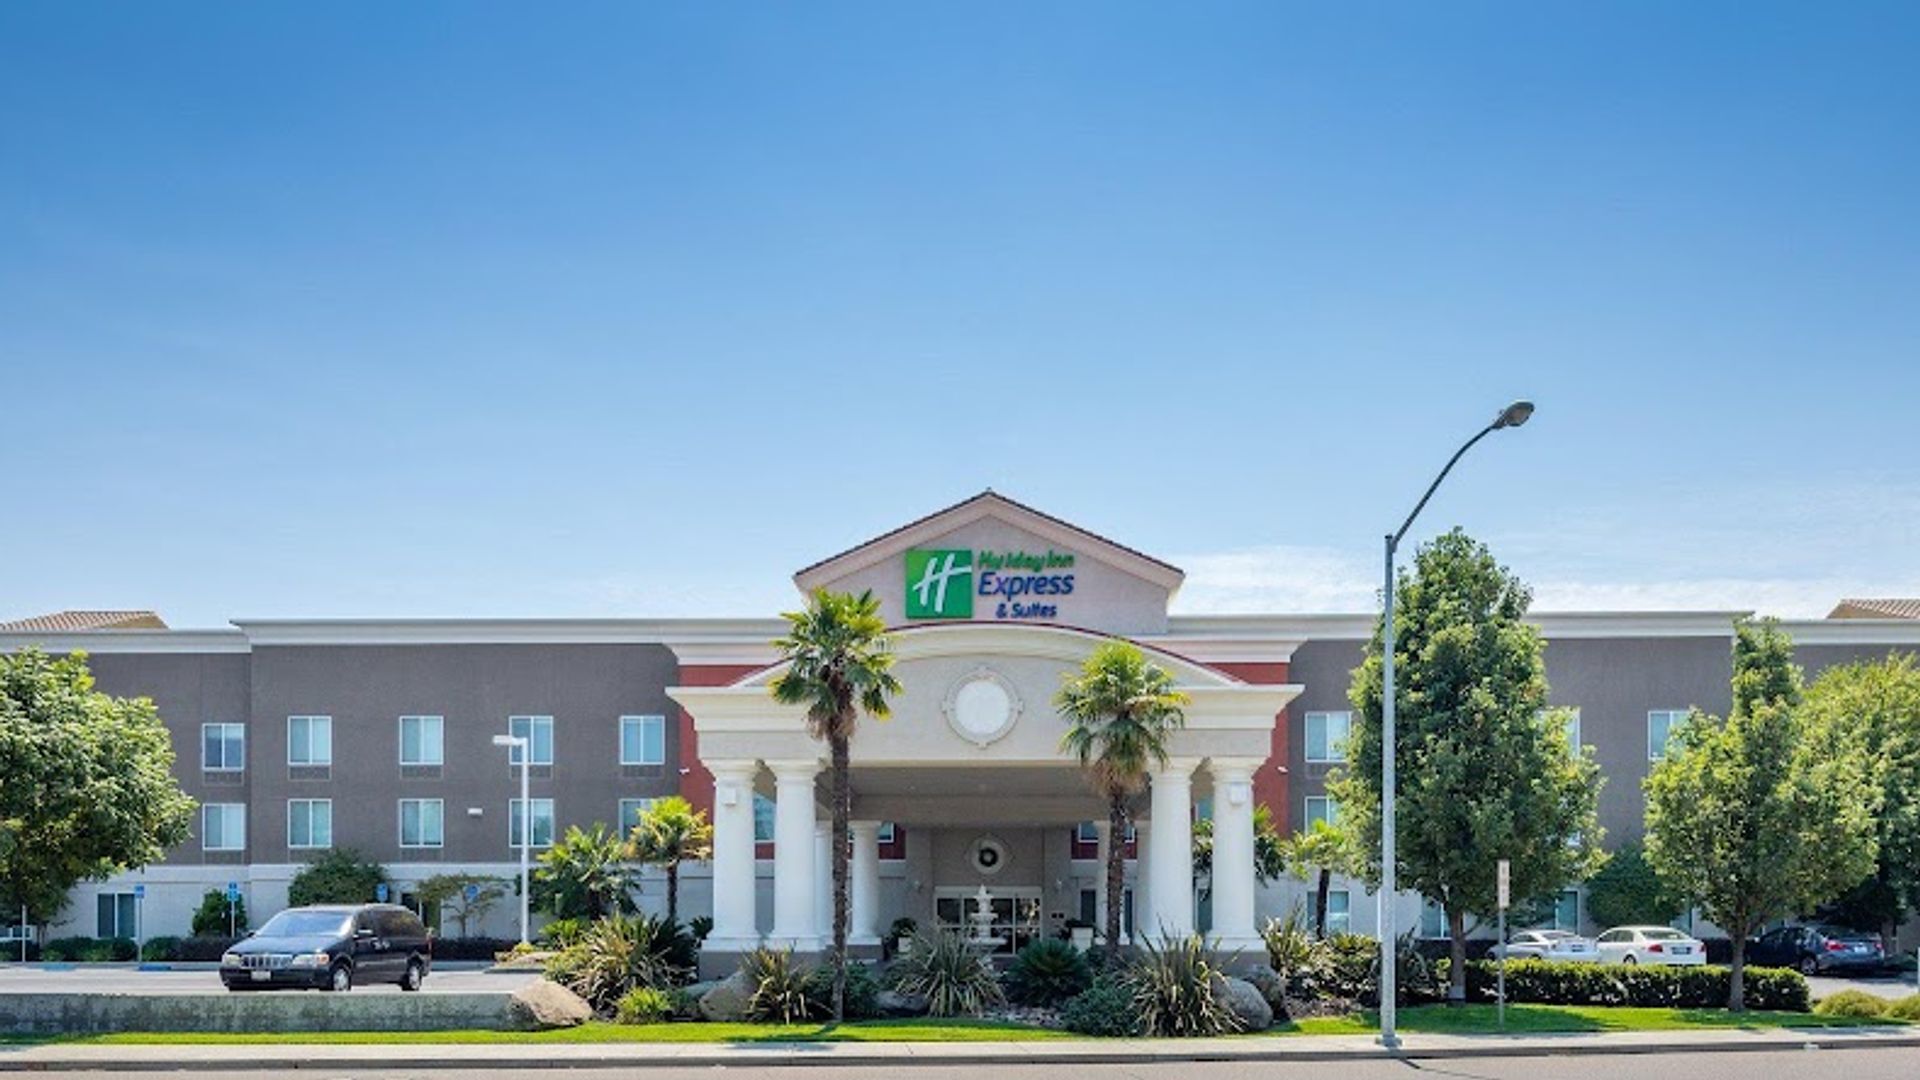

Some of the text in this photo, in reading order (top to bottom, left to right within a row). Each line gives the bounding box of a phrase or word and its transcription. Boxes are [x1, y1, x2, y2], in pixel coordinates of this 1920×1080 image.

[1047, 550, 1075, 568] Inn
[979, 572, 1075, 602] Express
[996, 602, 1057, 619] & Suites
